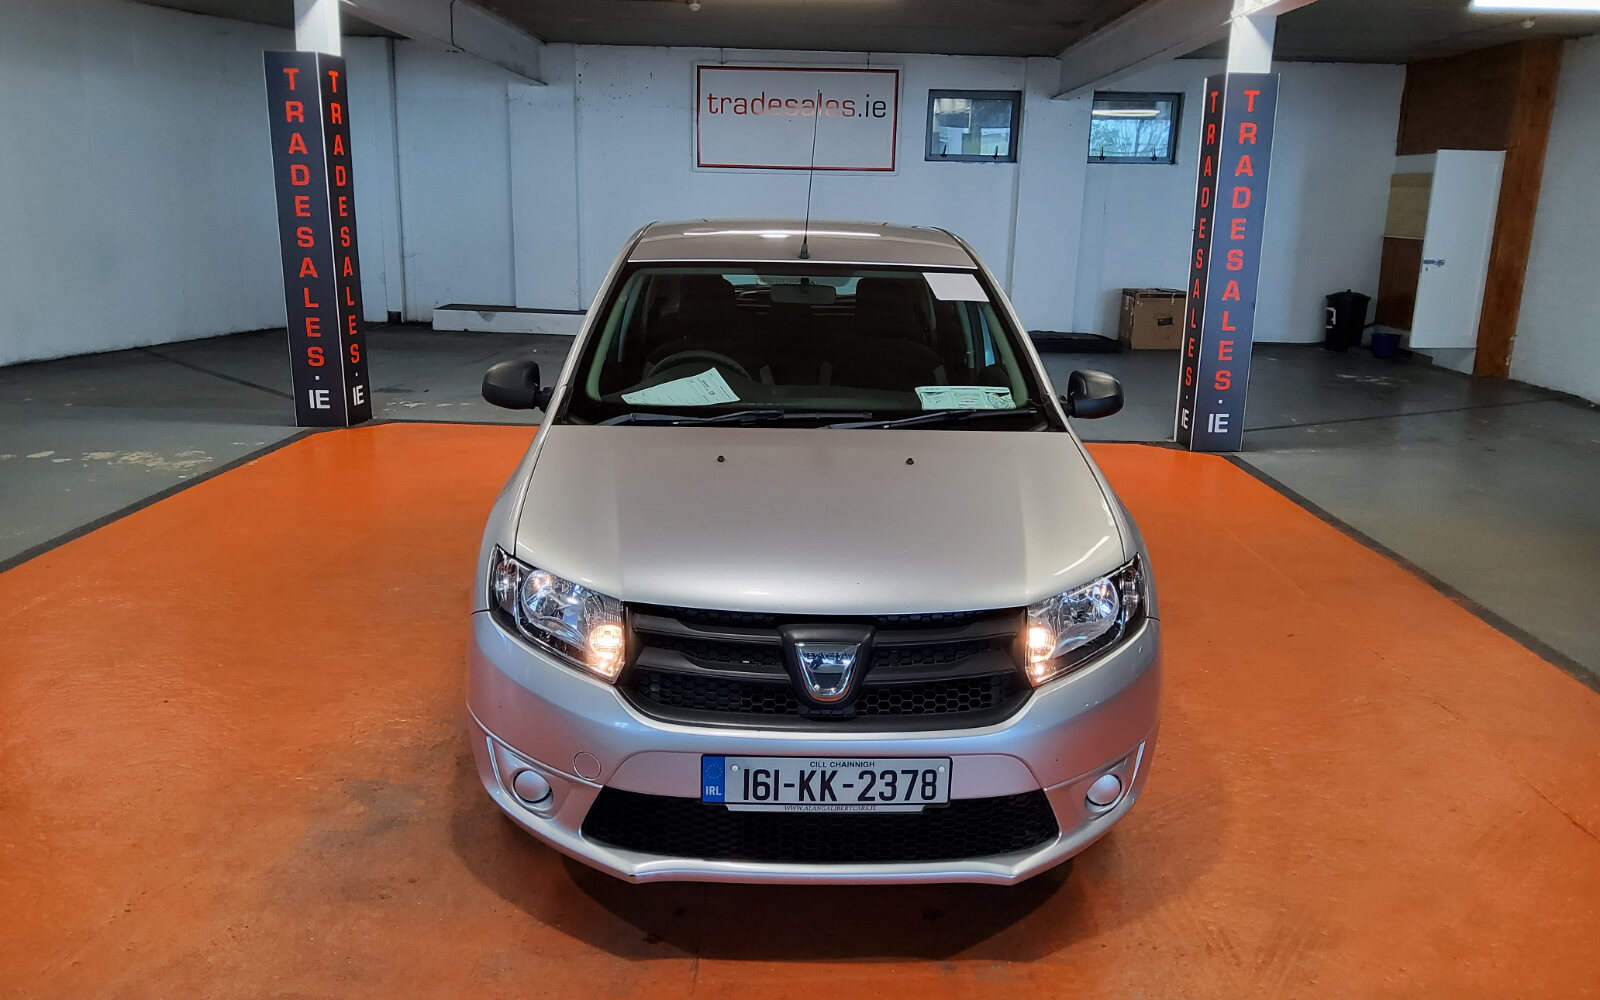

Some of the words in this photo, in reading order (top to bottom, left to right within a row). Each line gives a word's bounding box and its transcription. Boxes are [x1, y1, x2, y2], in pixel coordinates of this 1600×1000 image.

[707, 91, 887, 118] tradesales.ie
[806, 652, 849, 660] DACIA
[705, 785, 722, 796] IRL
